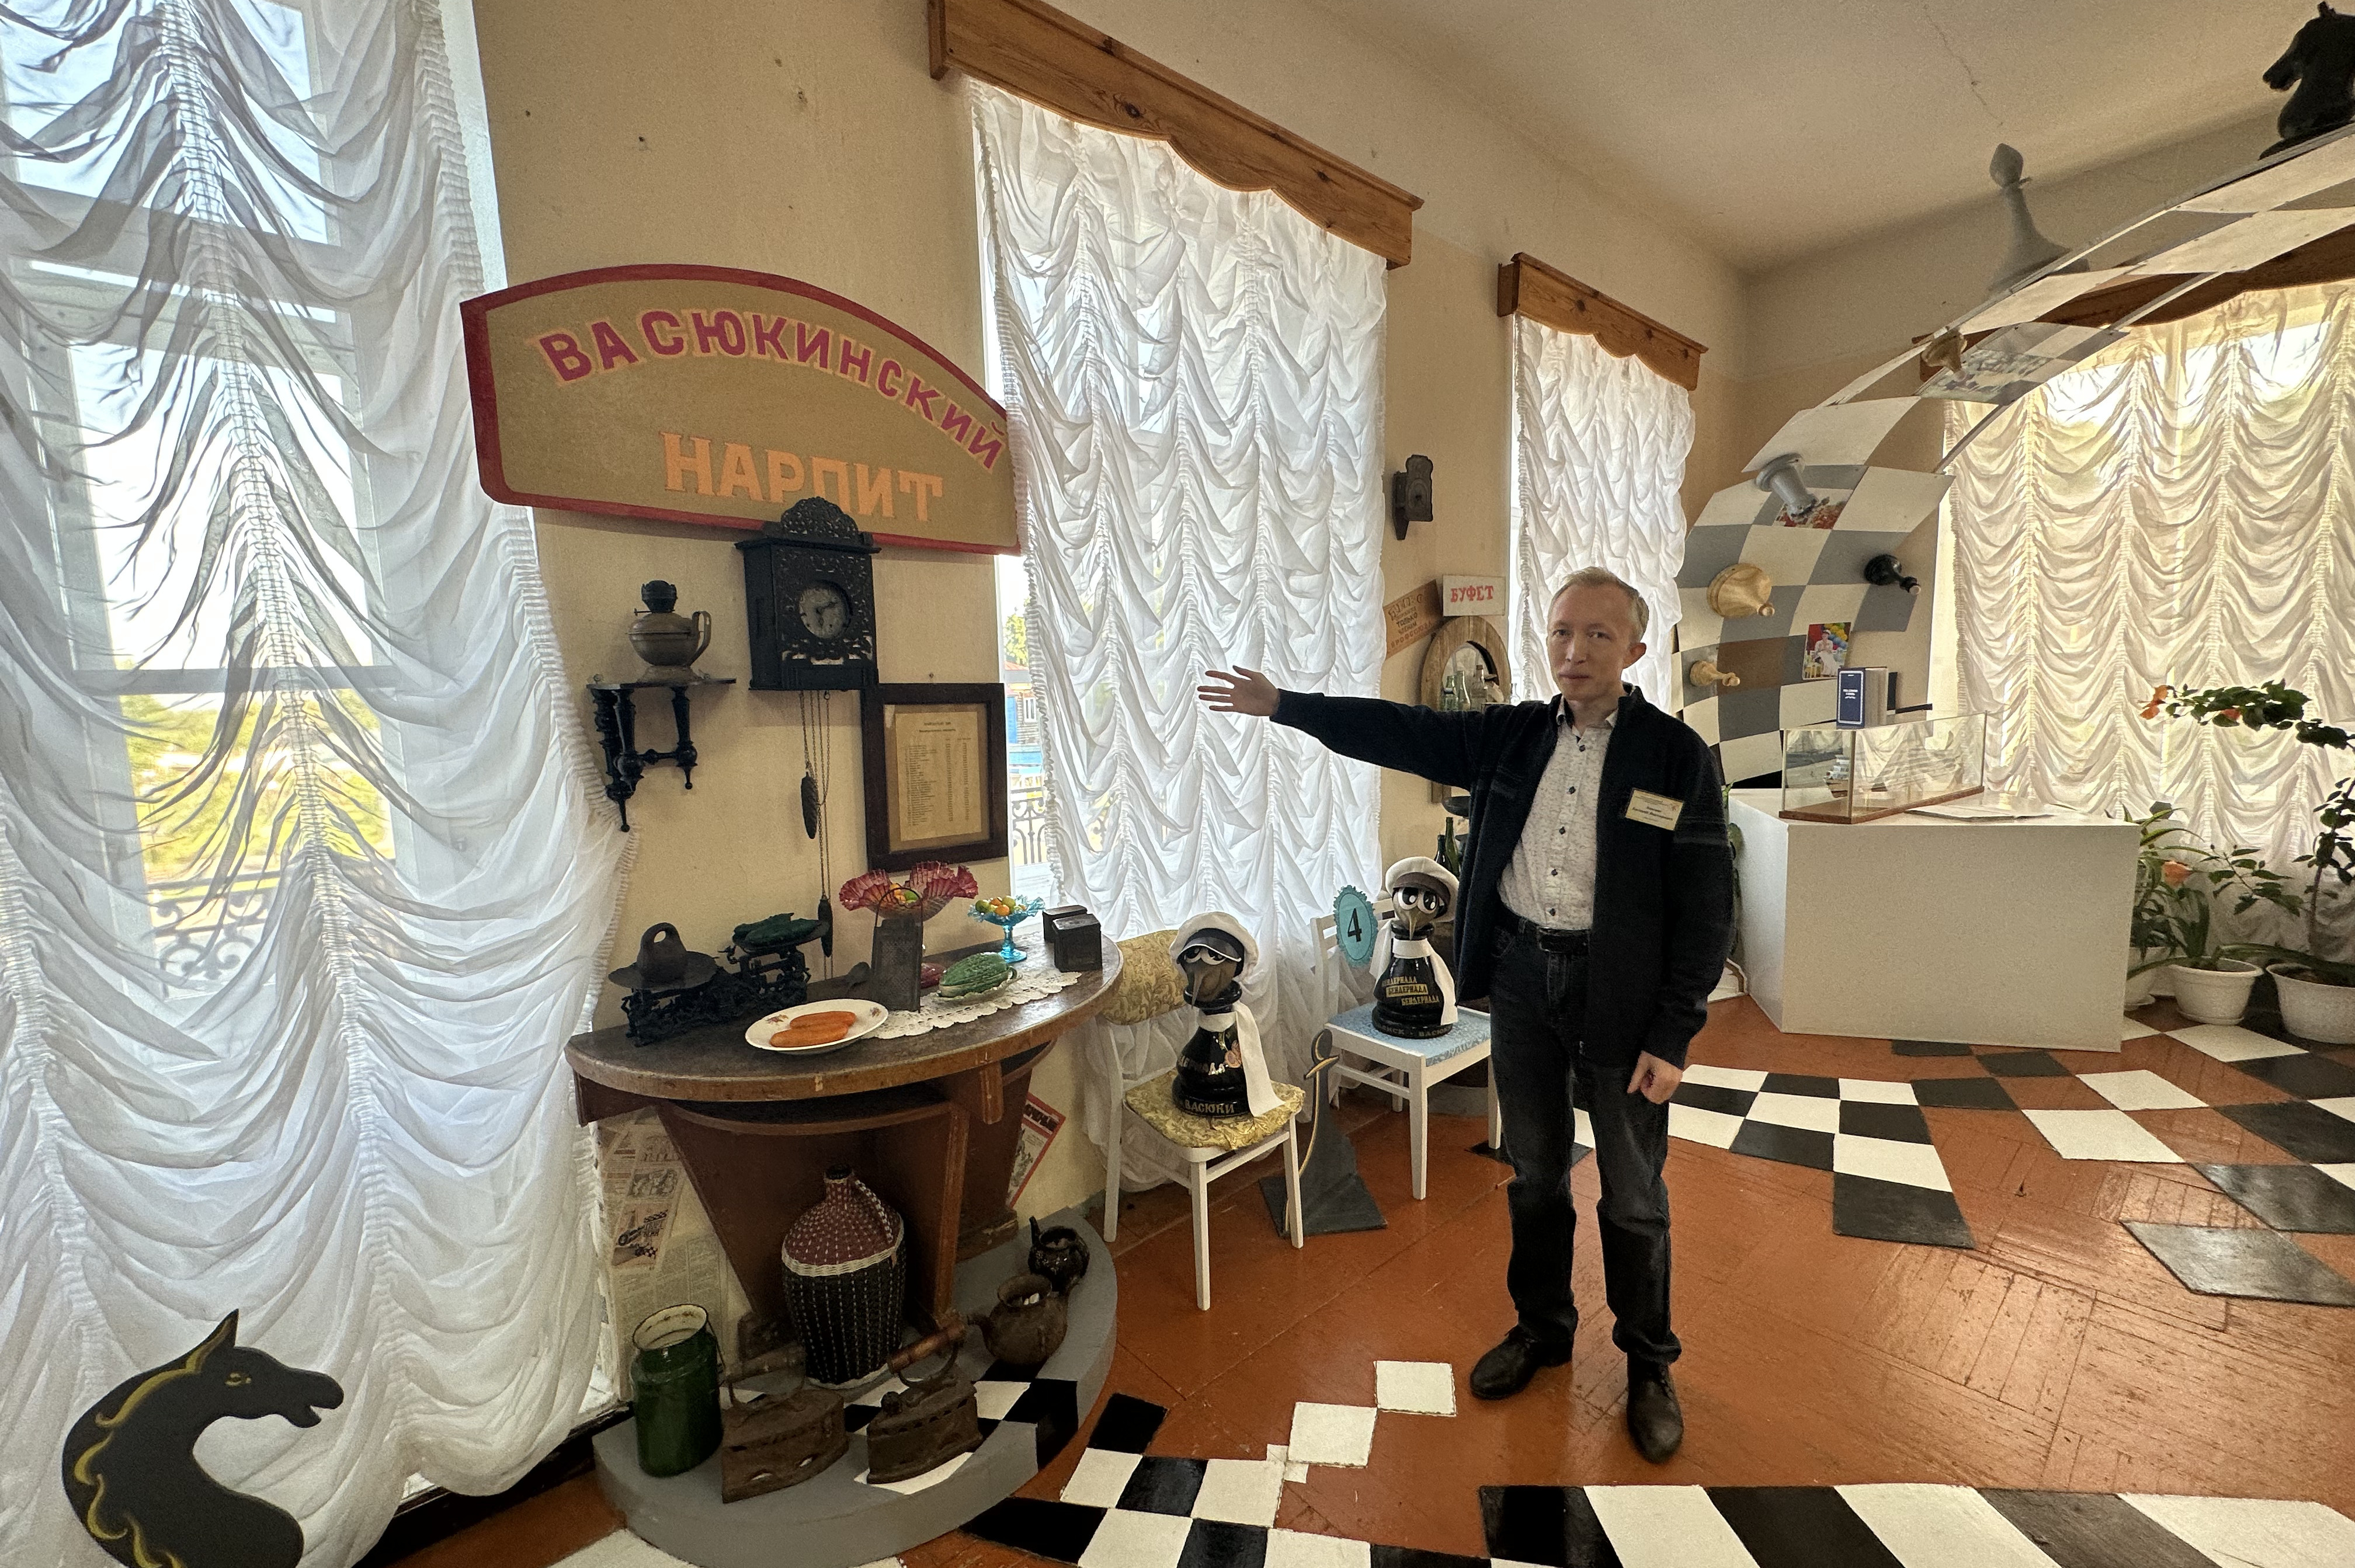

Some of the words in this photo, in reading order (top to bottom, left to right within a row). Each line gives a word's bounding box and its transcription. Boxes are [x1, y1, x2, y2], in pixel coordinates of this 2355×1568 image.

[537, 308, 1008, 469] ВАСЮКИНСКИЙ
[659, 432, 943, 521] НАРПИТ
[1450, 586, 1494, 603] БУФЕТ
[1347, 908, 1362, 942] 4
[1185, 1100, 1235, 1113] ВАСЮКИ
